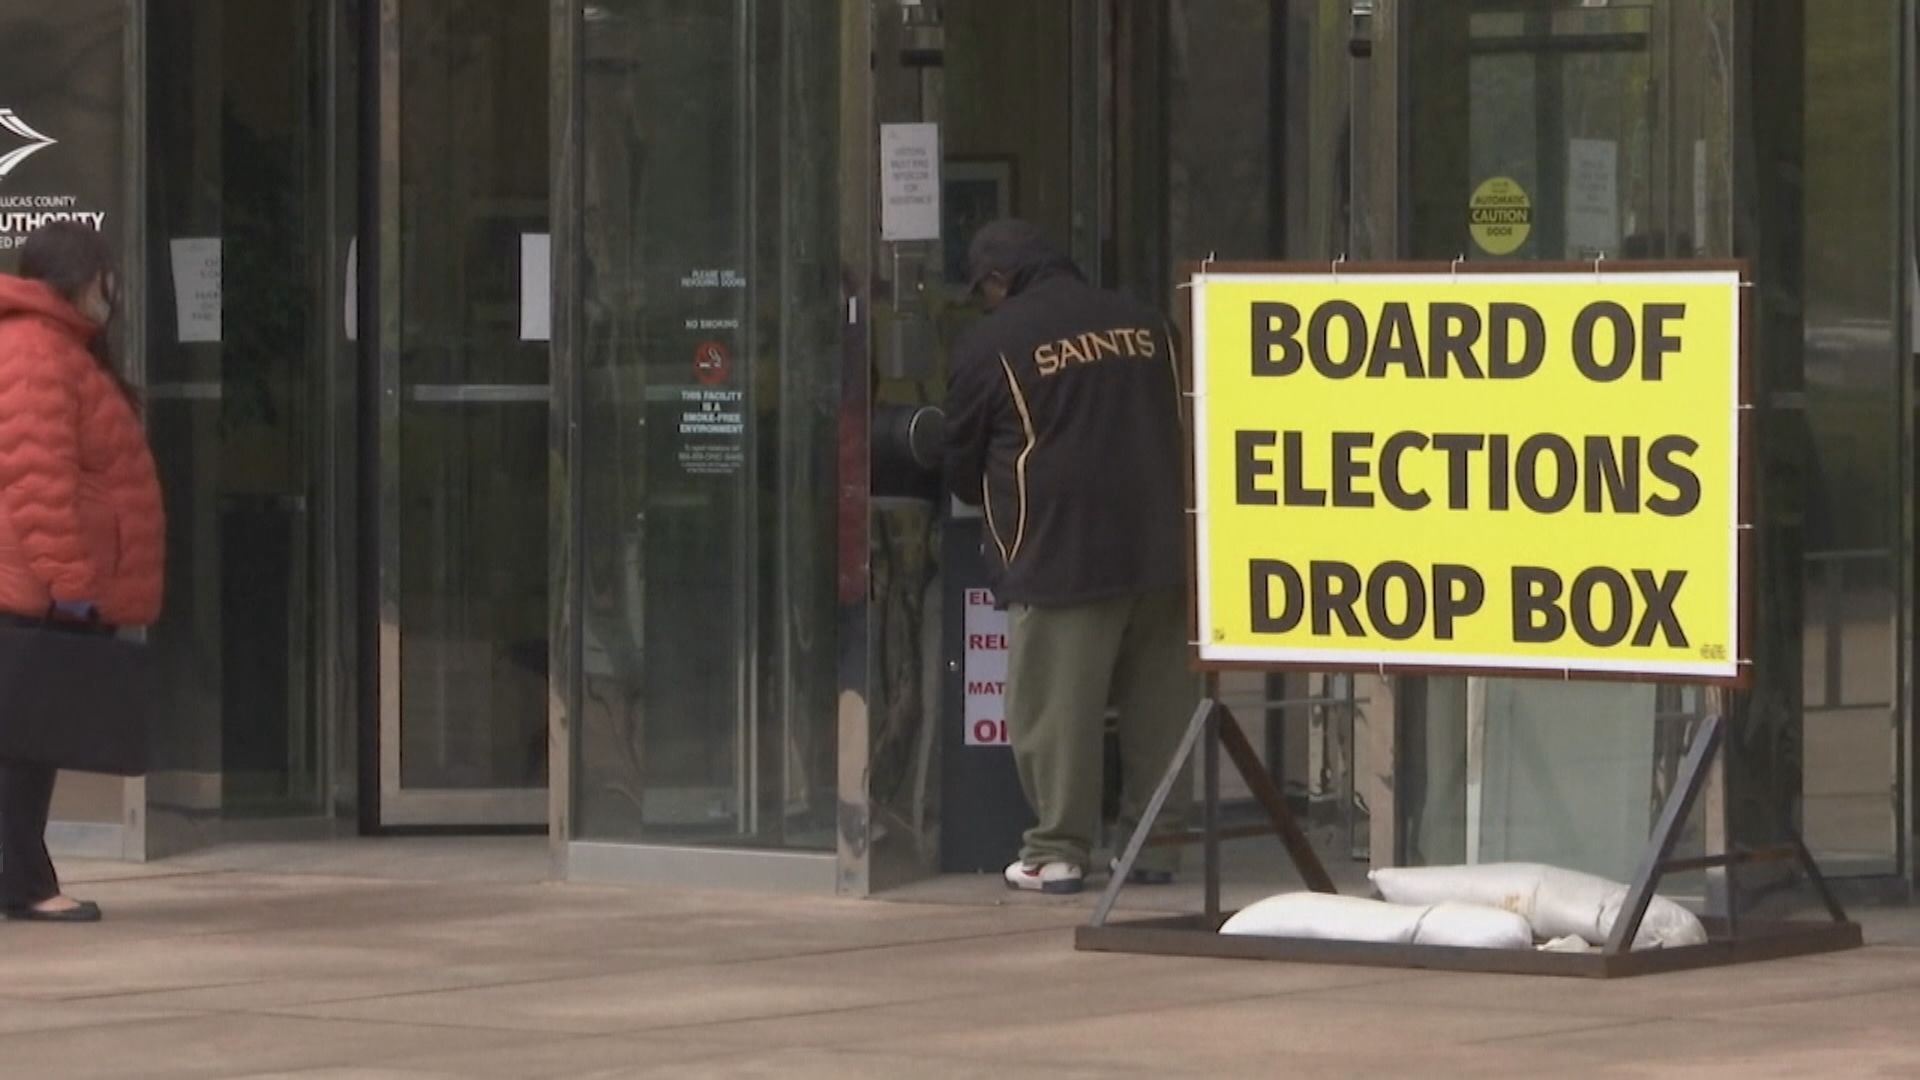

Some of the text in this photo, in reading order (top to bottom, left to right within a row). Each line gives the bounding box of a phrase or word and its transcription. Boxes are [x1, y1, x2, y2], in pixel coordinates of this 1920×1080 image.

[34, 197, 76, 207] COUNTY
[1475, 195, 1525, 204] AUTOMATIC
[1471, 209, 1528, 223] CAUTION
[1486, 226, 1512, 237] DOOR
[685, 319, 739, 329] NO SMOKING
[1250, 299, 1686, 383] BOARD OF
[1034, 328, 1155, 377] SAINTS
[682, 391, 742, 401] THIS FACILITY
[702, 401, 721, 411] IS A
[683, 412, 741, 423] SMOKE-FREE
[680, 423, 743, 433] ENVIRONMENT
[1234, 429, 1702, 517] ELECTIONS
[1248, 558, 1690, 649] DROP BOX
